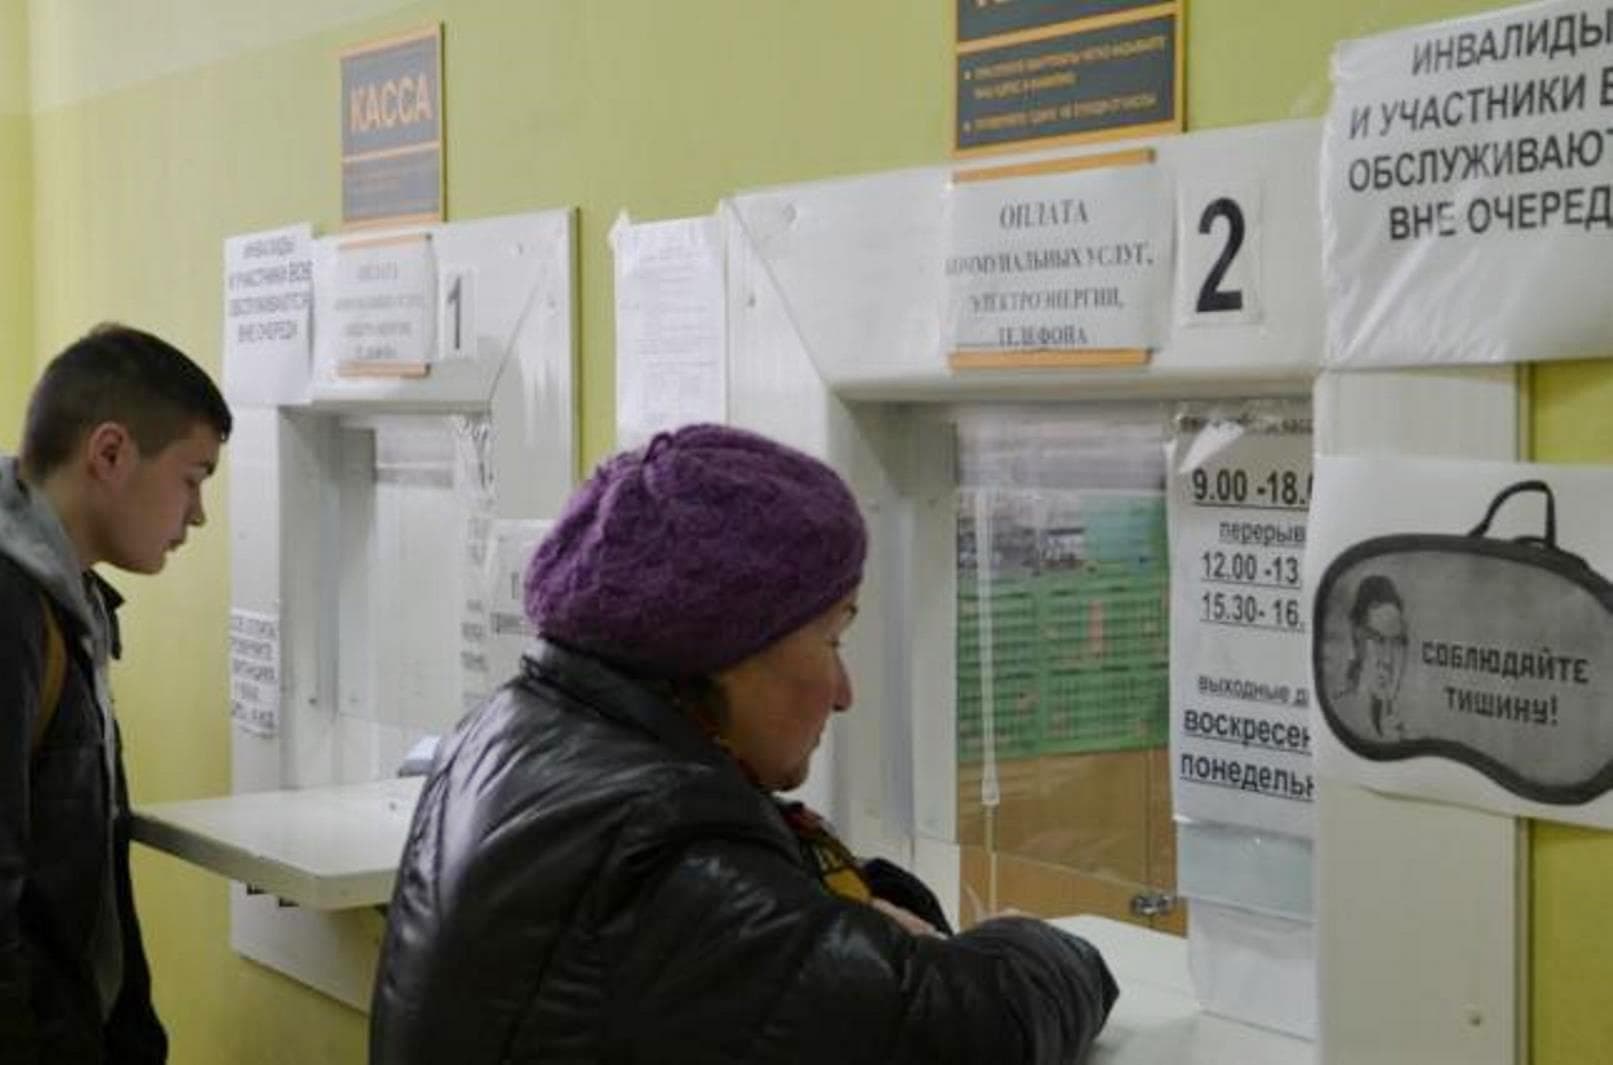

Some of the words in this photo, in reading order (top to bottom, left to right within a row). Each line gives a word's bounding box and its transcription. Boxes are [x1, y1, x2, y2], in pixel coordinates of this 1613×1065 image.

[1411, 8, 1613, 76] ИНВАЛИДЫ
[350, 72, 433, 133] КАССА
[1349, 105, 1372, 140] И
[1378, 72, 1587, 137] УЧАСТНИКИ
[999, 200, 1089, 230] ОПЛАТА
[1389, 200, 1457, 241] ВНЕ
[1467, 185, 1613, 235] ОЧЕРЕД
[1195, 197, 1246, 314] 2
[446, 274, 462, 350] 1
[1192, 467, 1248, 503] 9.00
[1219, 522, 1306, 547] перерыв
[1202, 551, 1257, 580] 12.00
[1421, 641, 1590, 685] СОБЛЮДАЙТЕ
[1198, 674, 1290, 702] выходные
[1444, 685, 1558, 727] ТИШИНУ!
